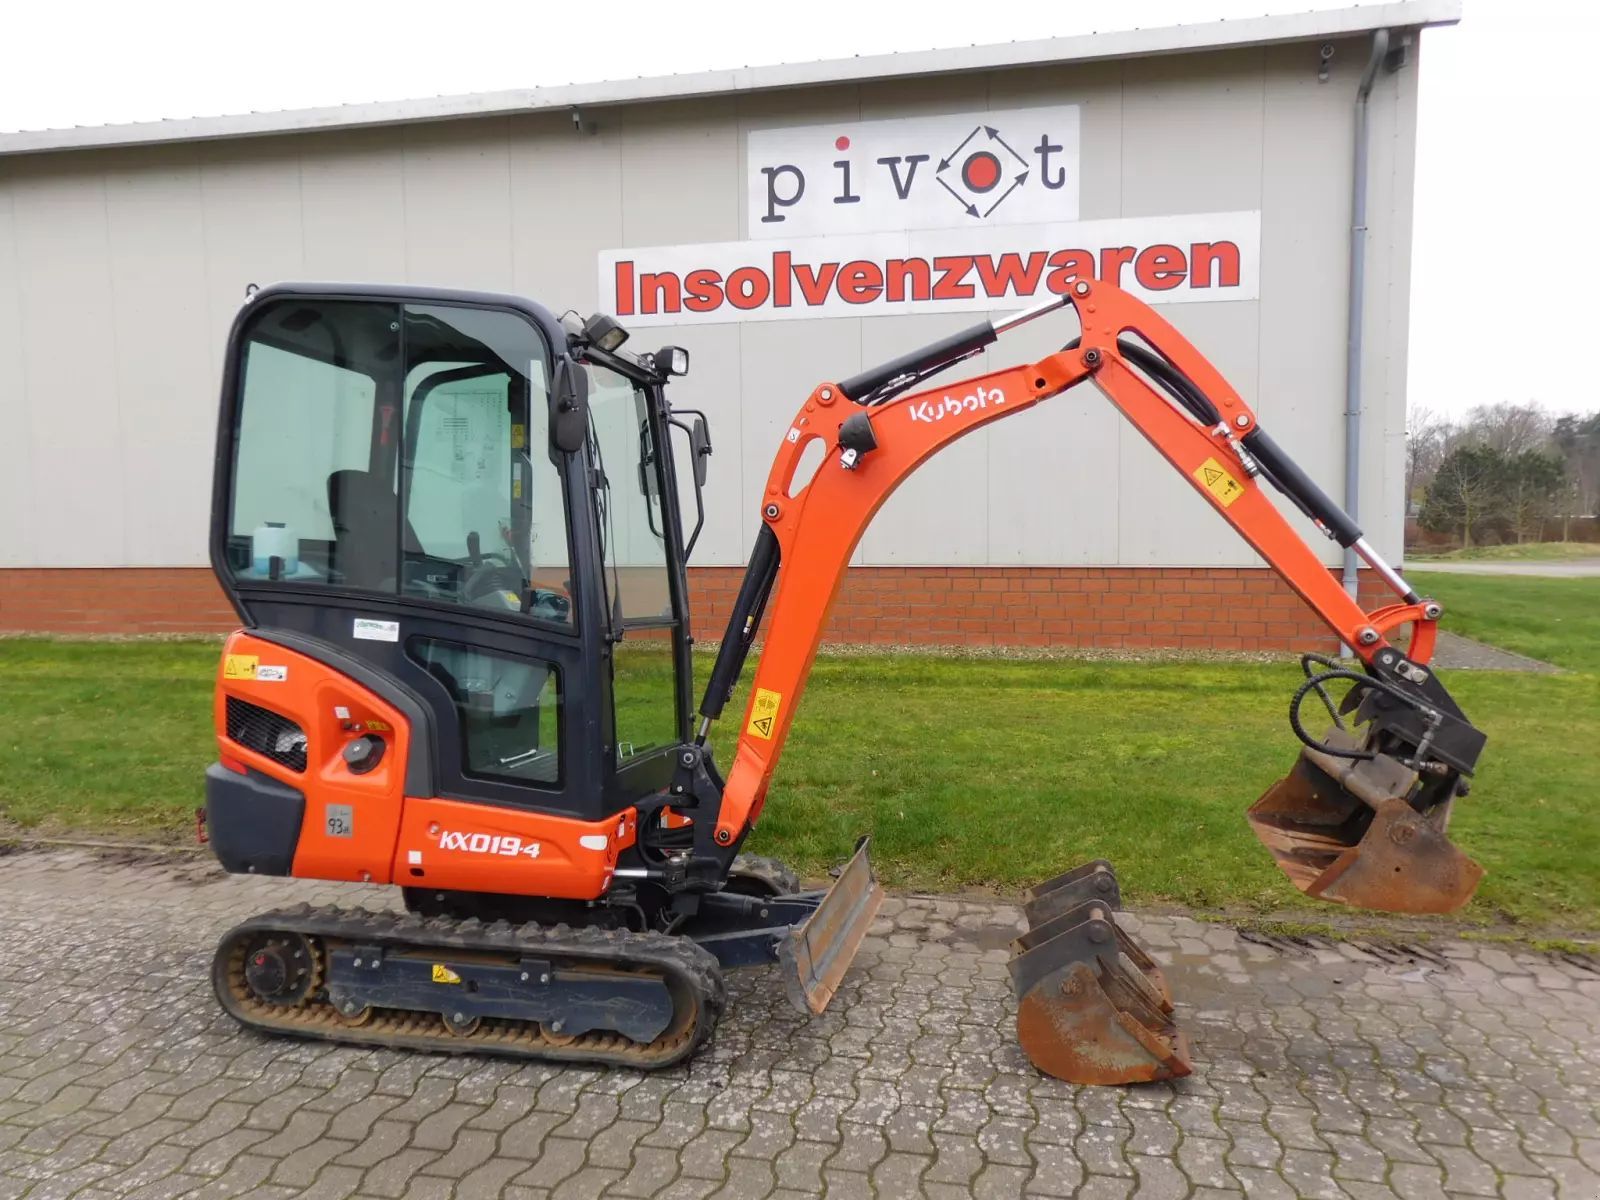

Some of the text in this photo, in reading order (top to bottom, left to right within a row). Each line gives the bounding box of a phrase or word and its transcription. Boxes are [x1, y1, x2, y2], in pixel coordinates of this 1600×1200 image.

[761, 134, 1066, 222] pivot
[615, 240, 1240, 315] Insolvenzwaren
[909, 387, 1005, 422] Kubota
[328, 818, 343, 834] 93
[439, 831, 540, 858] KX019-4
